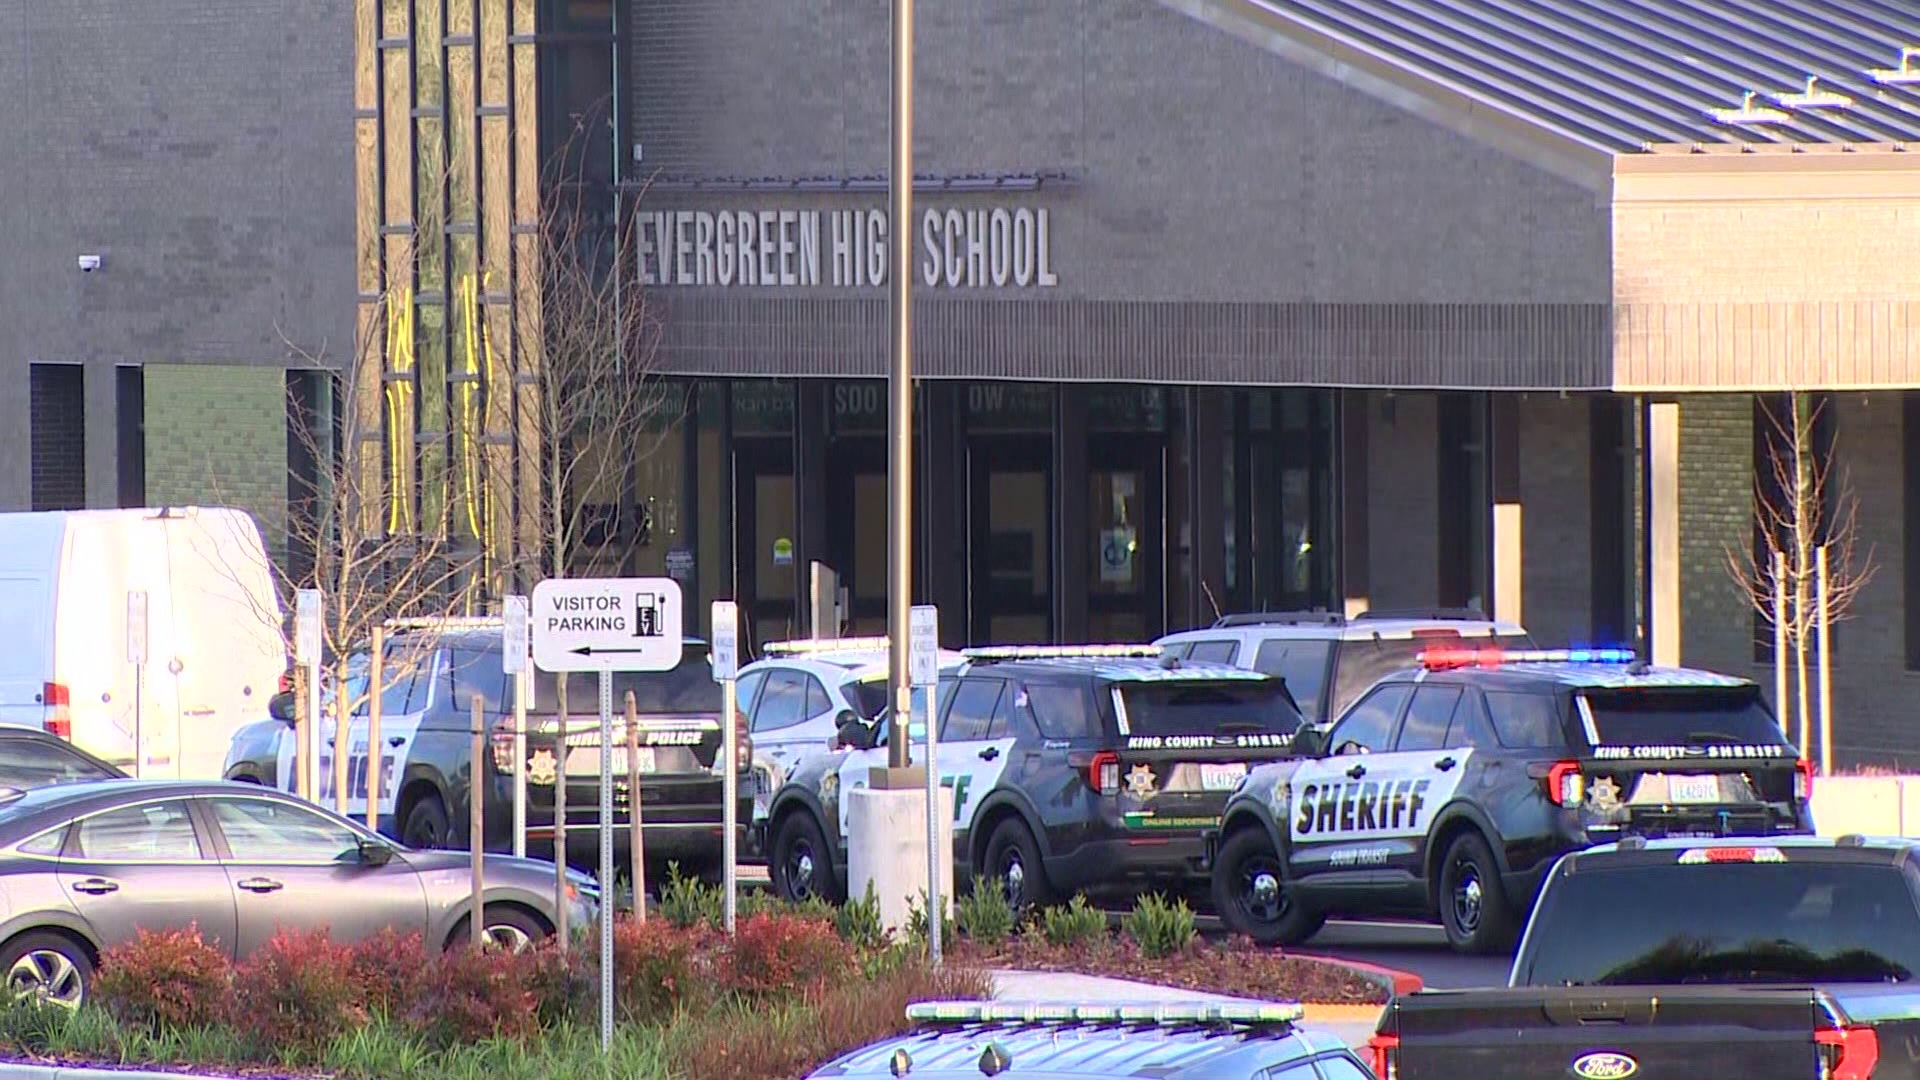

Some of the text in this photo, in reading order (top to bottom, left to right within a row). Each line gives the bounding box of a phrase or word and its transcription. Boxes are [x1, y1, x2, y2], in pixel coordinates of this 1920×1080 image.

[636, 207, 1057, 287] EVERGREEN HIG SCHOOL
[552, 596, 622, 610] VISITOR
[548, 616, 626, 631] PARKING
[646, 731, 703, 745] POLICE
[1128, 734, 1294, 748] KING COUNTY SHERI
[1594, 745, 1782, 759] KING COUNTY SHERIFF
[1296, 779, 1431, 835] SHERIFF
